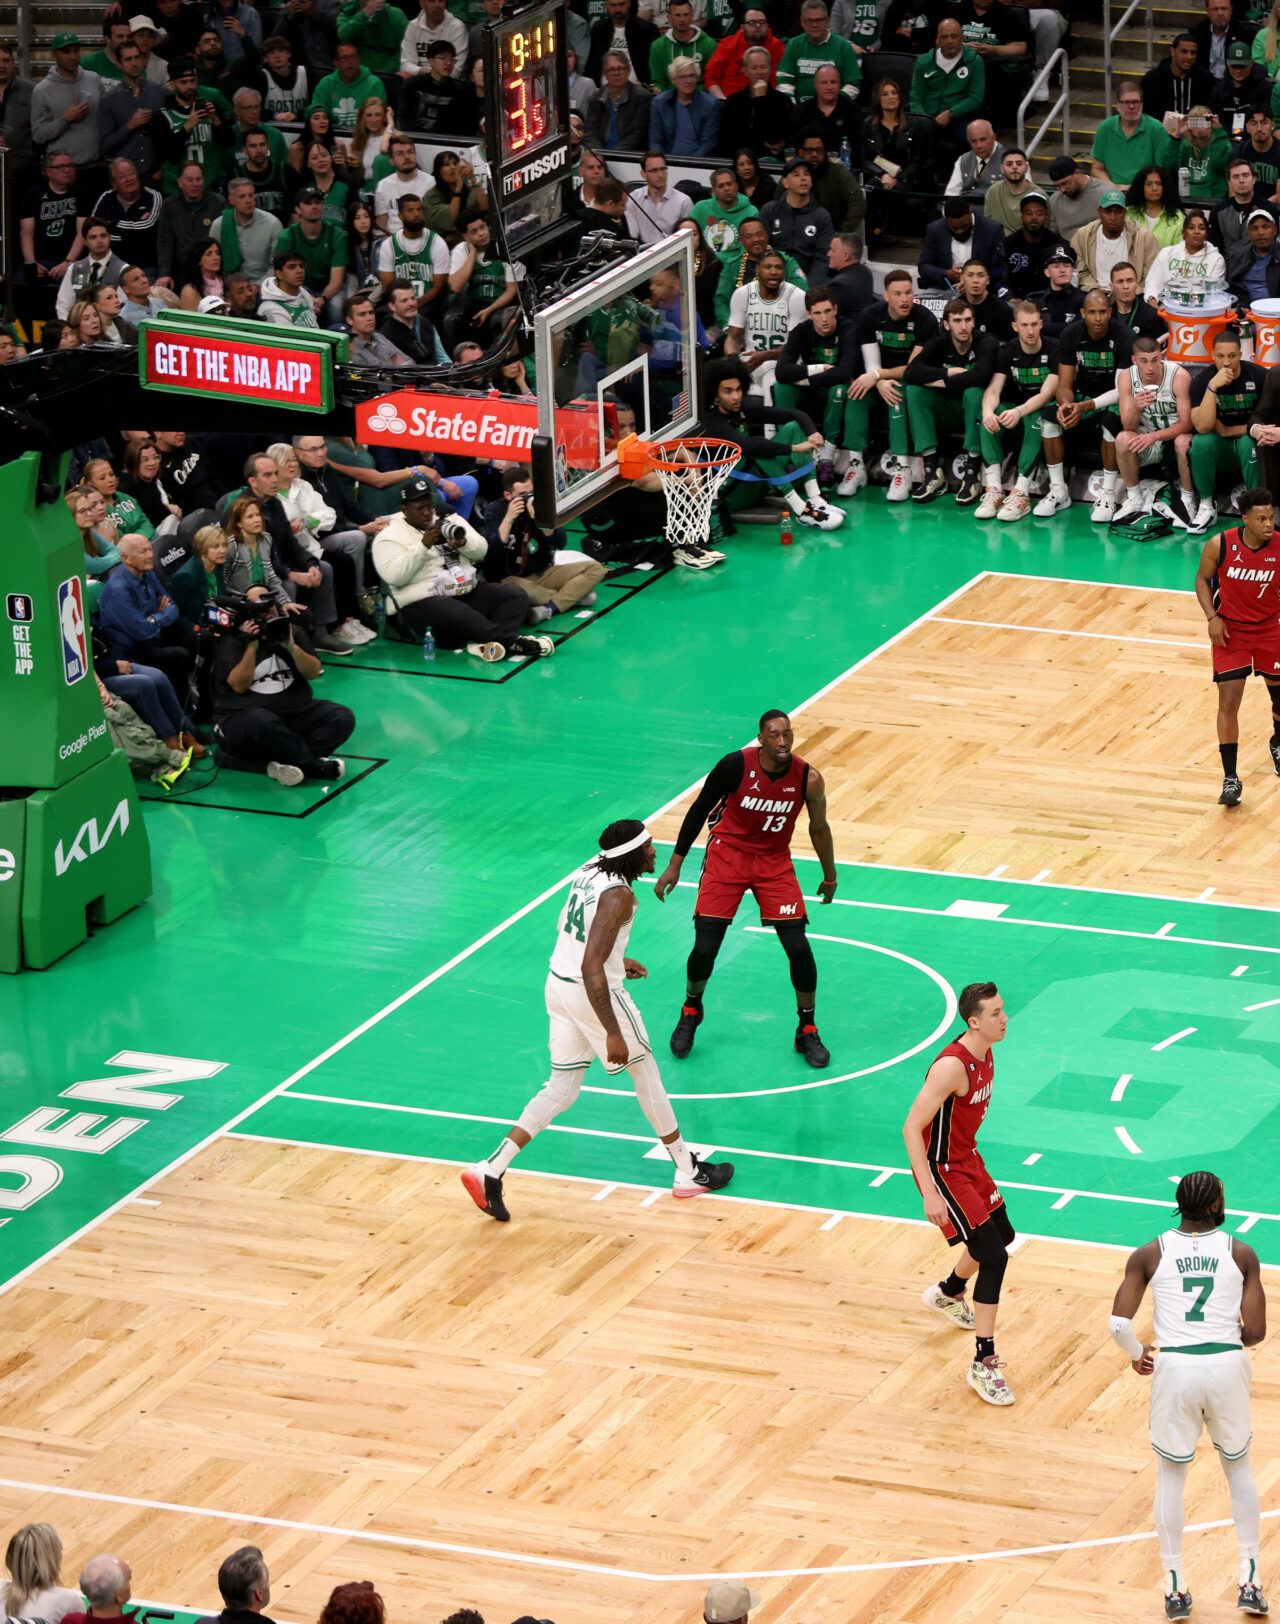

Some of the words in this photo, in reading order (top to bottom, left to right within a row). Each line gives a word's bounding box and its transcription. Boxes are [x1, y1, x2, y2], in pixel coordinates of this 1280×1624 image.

[511, 20, 555, 73] 9:11
[522, 145, 568, 187] TISSOT
[395, 261, 434, 282] BOSTON
[748, 312, 788, 333] CELTICS
[1178, 326, 1195, 345] G
[1260, 327, 1275, 346] G
[155, 341, 190, 377] GET
[193, 347, 230, 383] THE
[233, 354, 272, 390] NBA
[275, 359, 313, 394] APP
[409, 407, 477, 442] State
[477, 415, 540, 449] Farm
[1226, 566, 1275, 583] MIAMI
[1256, 583, 1268, 599] 7
[13, 625, 30, 642] GET
[14, 642, 33, 659] THE
[15, 660, 33, 675] APP
[59, 730, 88, 760] Google
[87, 719, 107, 742] Pixel
[740, 795, 795, 813] MIAMI
[761, 815, 788, 833] 13
[1175, 1255, 1220, 1275] BROWN
[1182, 1276, 1215, 1322] 7
